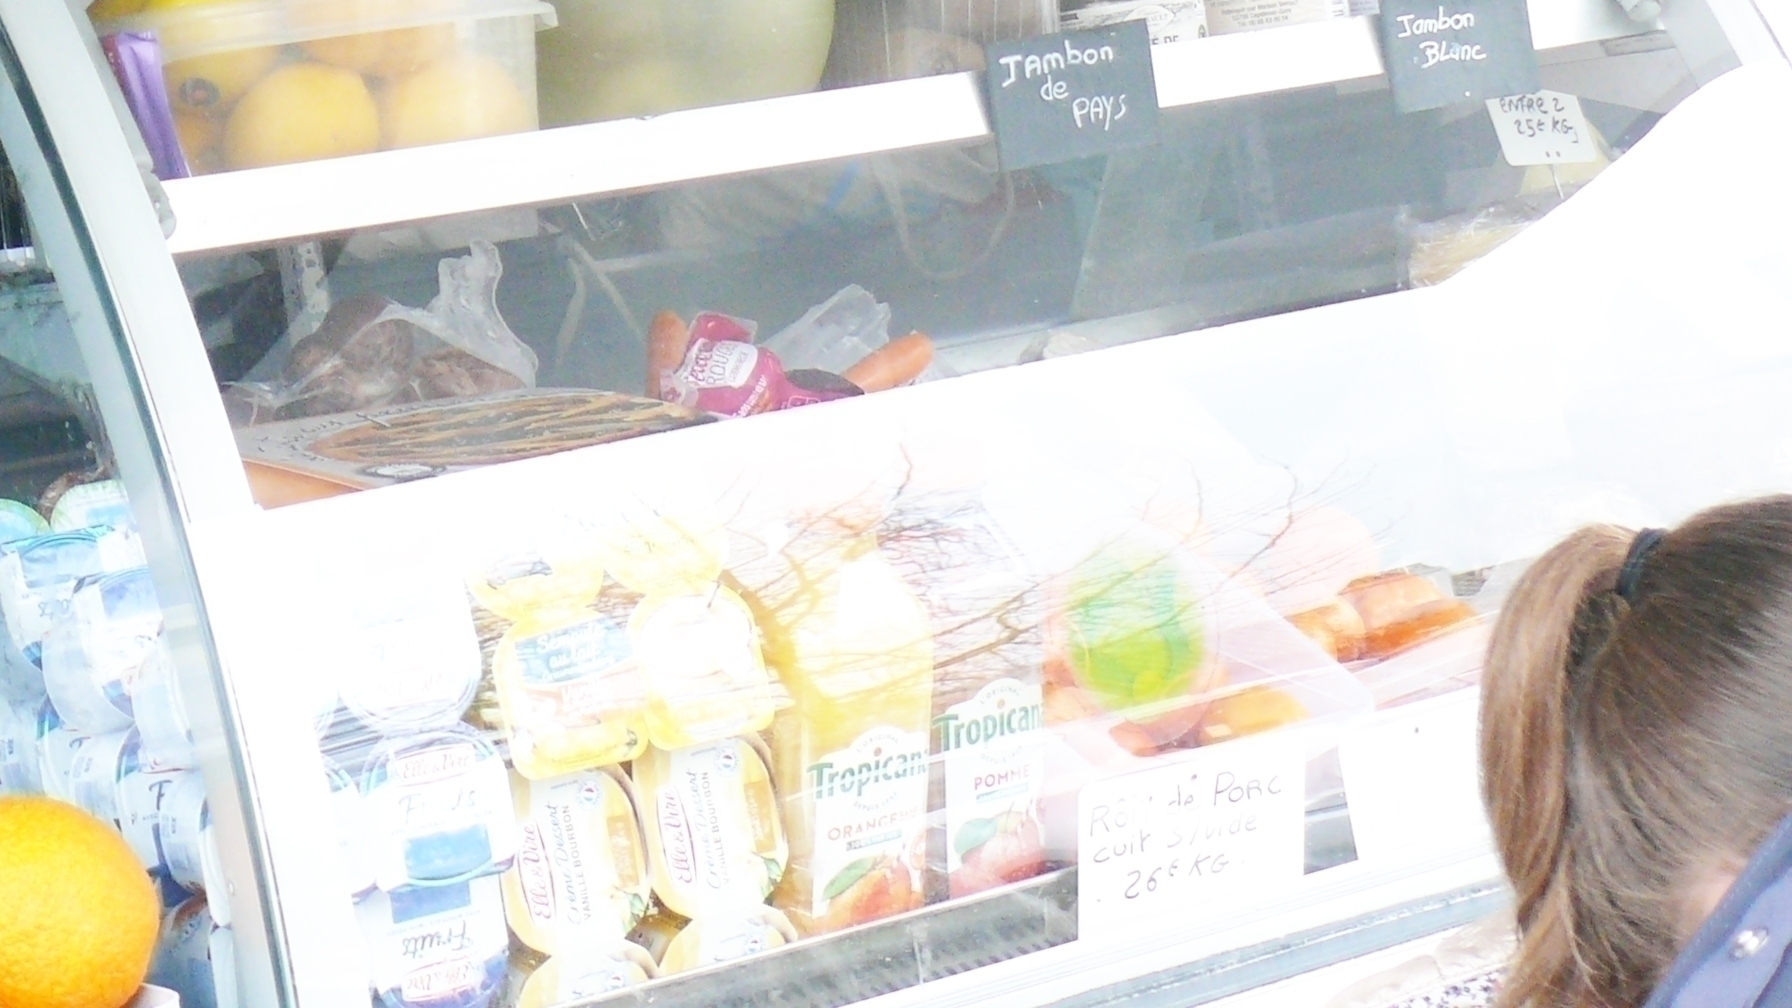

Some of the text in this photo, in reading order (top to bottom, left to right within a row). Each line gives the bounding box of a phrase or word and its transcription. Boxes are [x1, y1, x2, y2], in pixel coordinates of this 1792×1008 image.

[1396, 5, 1475, 39] Jambon
[1040, 75, 1069, 102] de
[1072, 93, 1127, 132] PAYS
[1551, 97, 1565, 113] 2
[973, 764, 1031, 791] POMME
[700, 772, 720, 833] BOURBON
[561, 805, 582, 868] BOURBON
[827, 812, 898, 842] ORANGE
